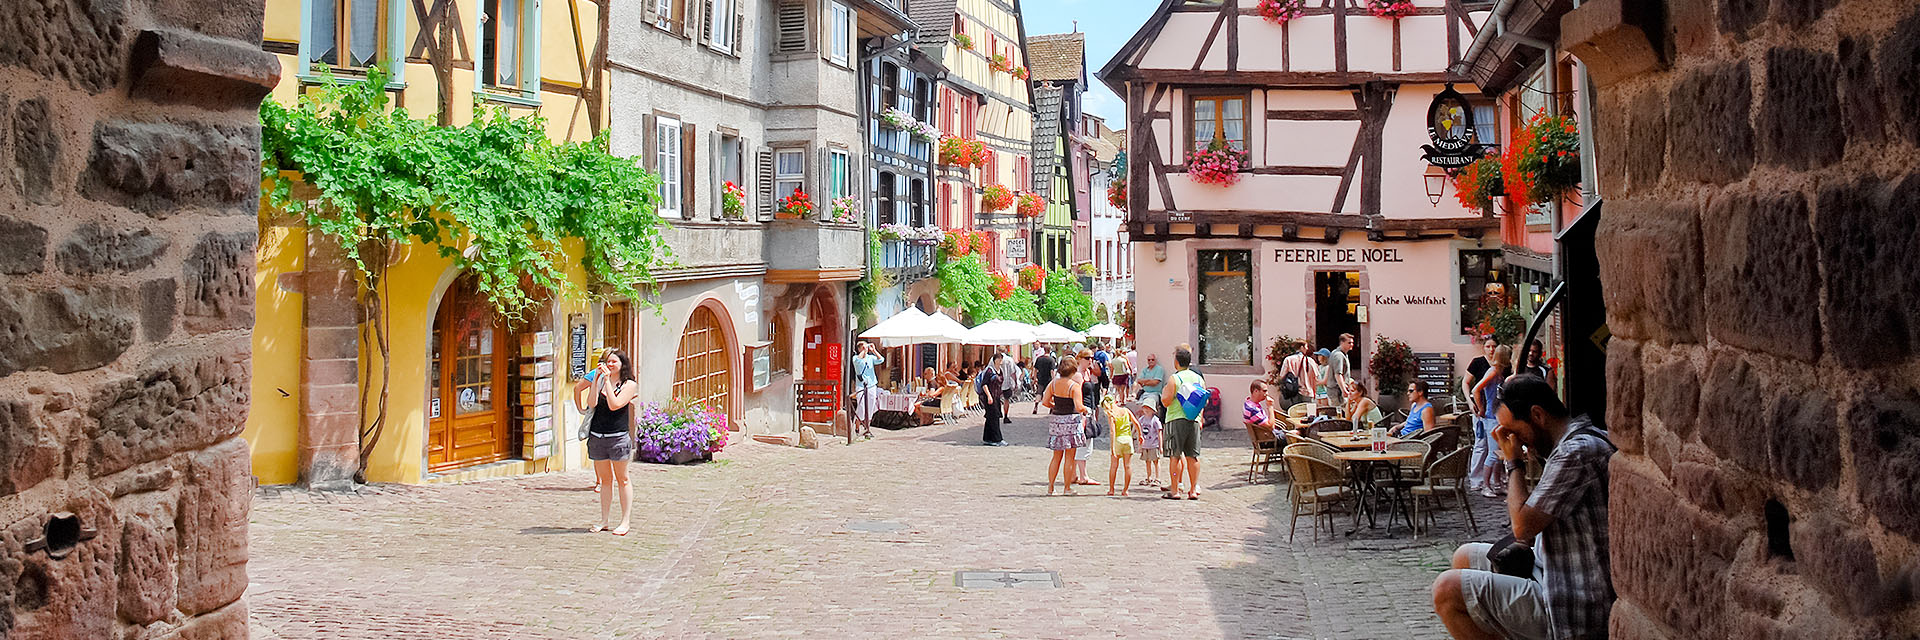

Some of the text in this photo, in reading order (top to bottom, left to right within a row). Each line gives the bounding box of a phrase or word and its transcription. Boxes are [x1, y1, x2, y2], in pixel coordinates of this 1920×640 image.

[1428, 127, 1436, 138] LE
[1431, 156, 1473, 165] RESTAURANT
[1274, 248, 1403, 262] FEERIE DE NOEL
[1404, 295, 1447, 305] Wohlfahrt
